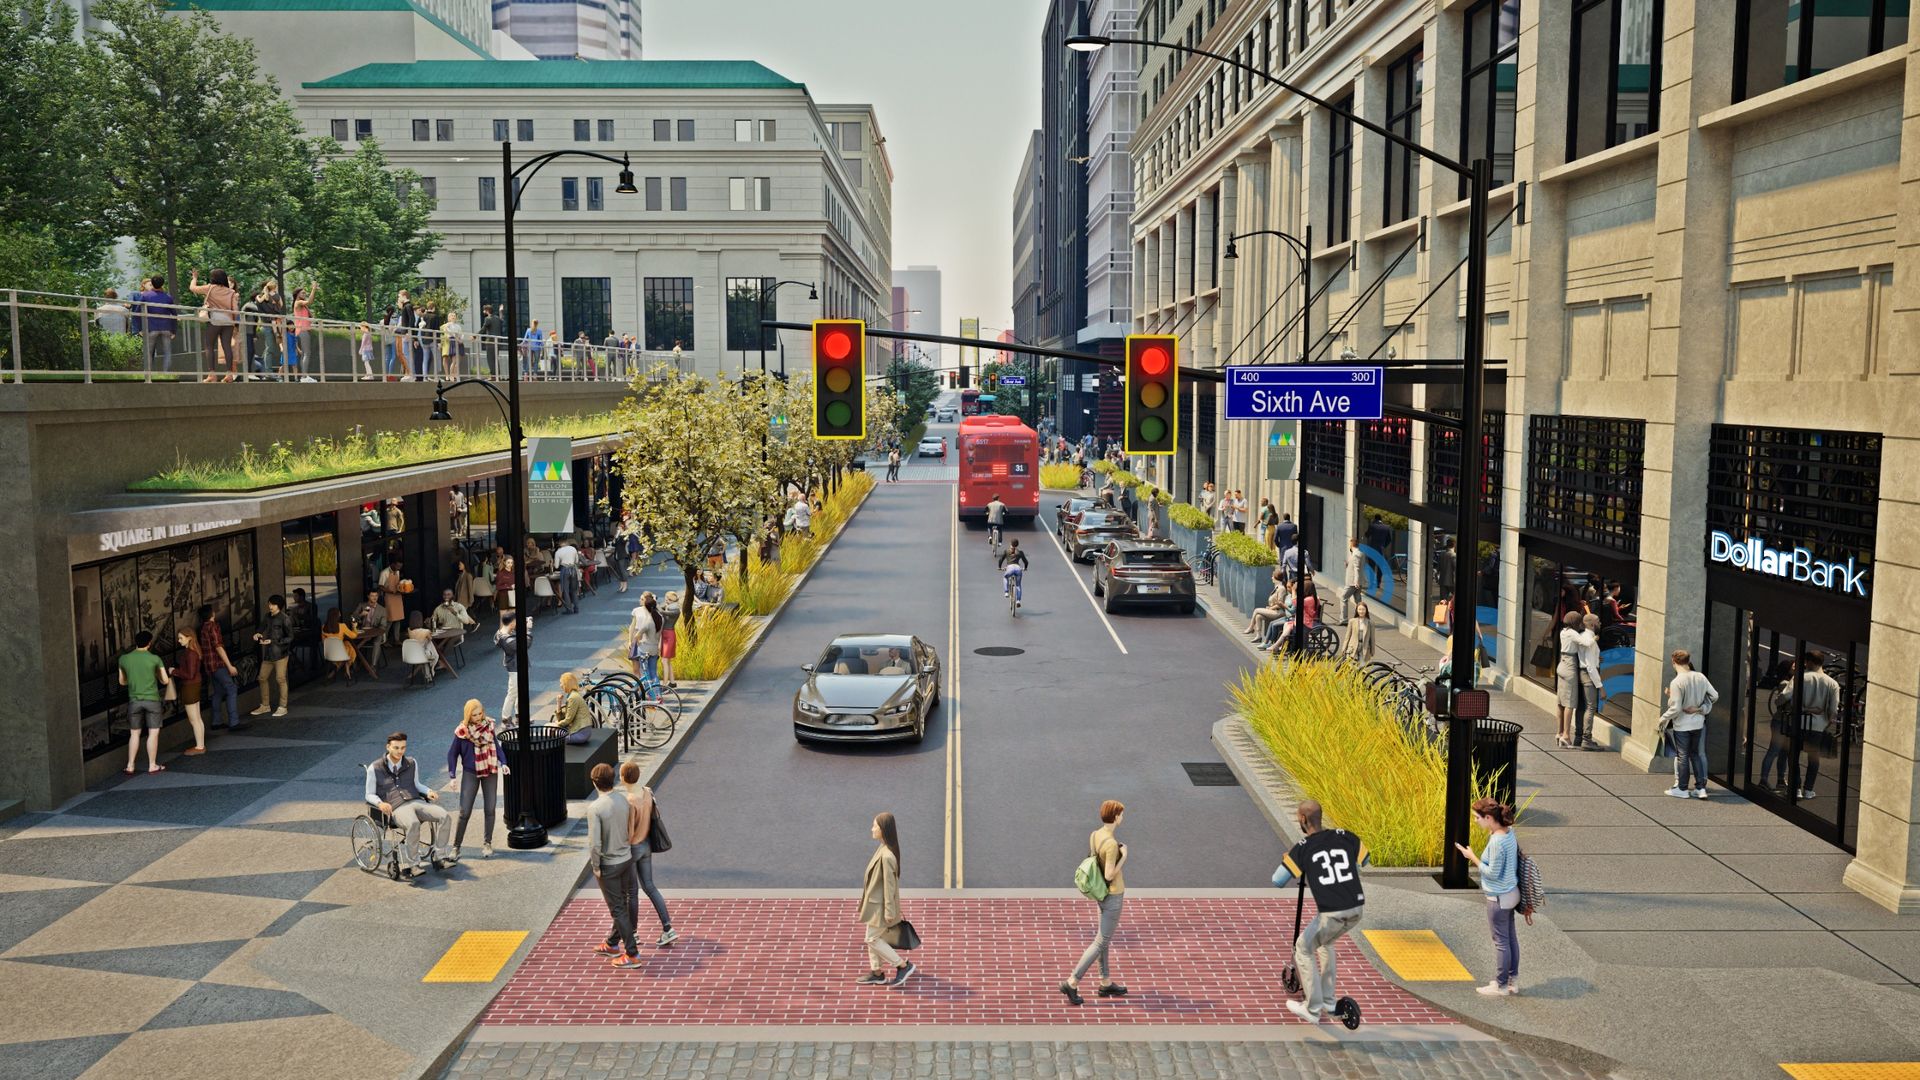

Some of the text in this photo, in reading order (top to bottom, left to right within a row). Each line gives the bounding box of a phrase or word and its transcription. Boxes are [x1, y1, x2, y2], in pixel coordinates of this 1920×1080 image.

[1241, 373, 1370, 382] 400 300
[1251, 390, 1351, 413] Sixth Ave
[1015, 464, 1024, 472] 31
[100, 527, 152, 552] SQUARE
[152, 526, 167, 540] IN
[168, 523, 191, 537] THE
[1312, 849, 1353, 885] 32
